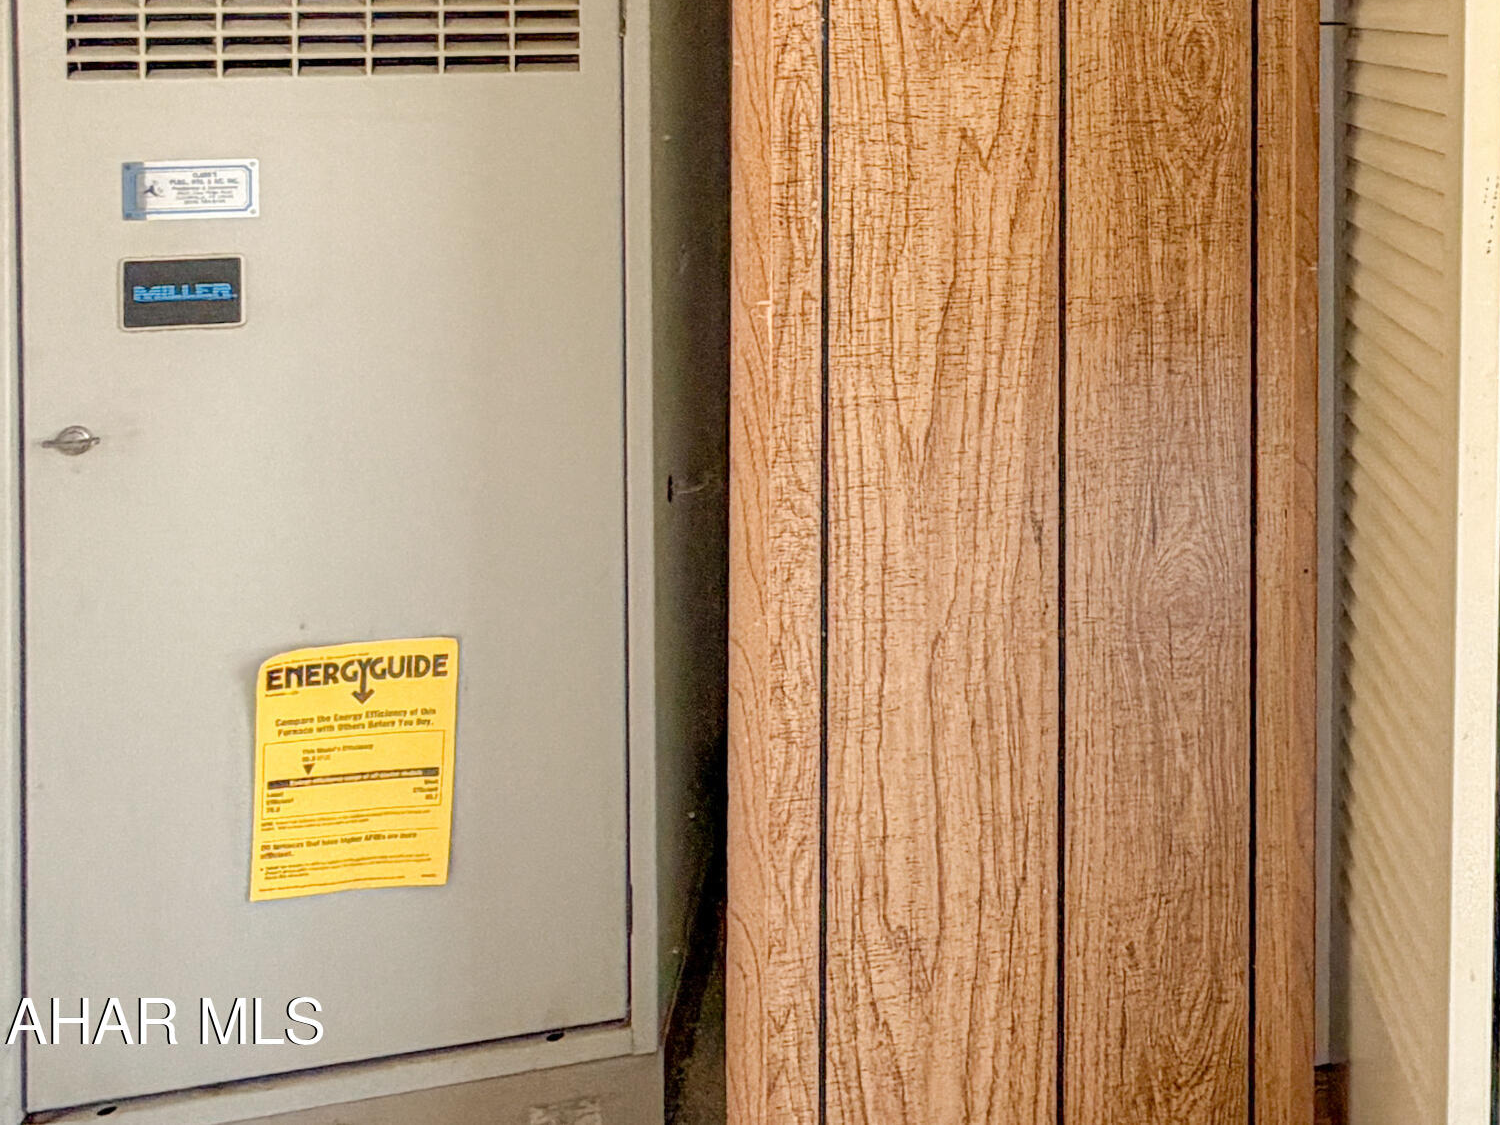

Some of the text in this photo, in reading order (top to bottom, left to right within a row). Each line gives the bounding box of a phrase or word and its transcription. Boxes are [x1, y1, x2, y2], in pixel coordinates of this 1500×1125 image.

[133, 282, 232, 303] MILLER
[265, 653, 449, 693] ENERGYGUIDE
[275, 707, 437, 728] Compare the Energy Efficiency of this
[277, 728, 314, 737] Furnace
[316, 725, 335, 734] with
[337, 722, 366, 731] Others
[367, 720, 396, 730] Before
[398, 718, 414, 727] You
